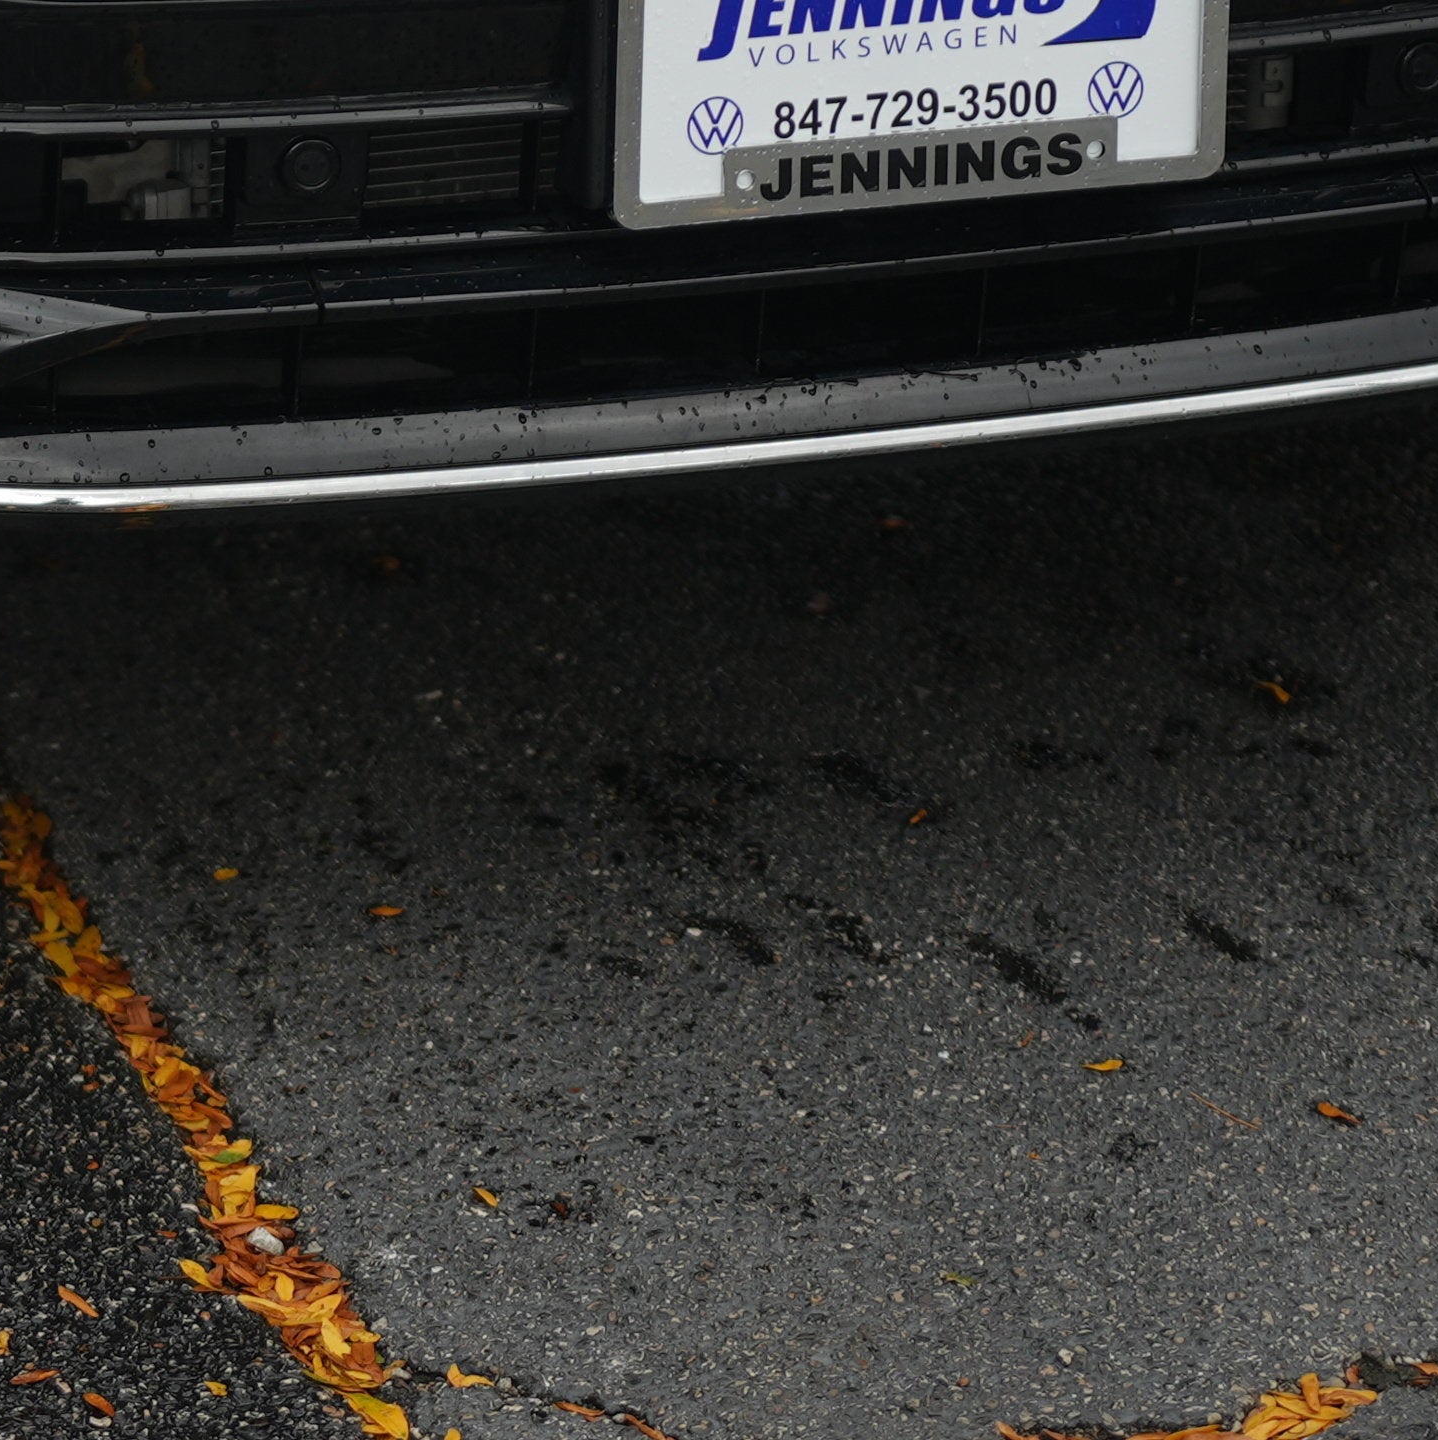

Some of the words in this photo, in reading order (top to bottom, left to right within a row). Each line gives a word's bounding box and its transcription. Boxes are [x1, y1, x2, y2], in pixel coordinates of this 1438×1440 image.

[748, 24, 1017, 68] VOLKSWAGEN
[773, 78, 1057, 139] 847-729-3500
[759, 132, 1084, 202] JENNINGS
